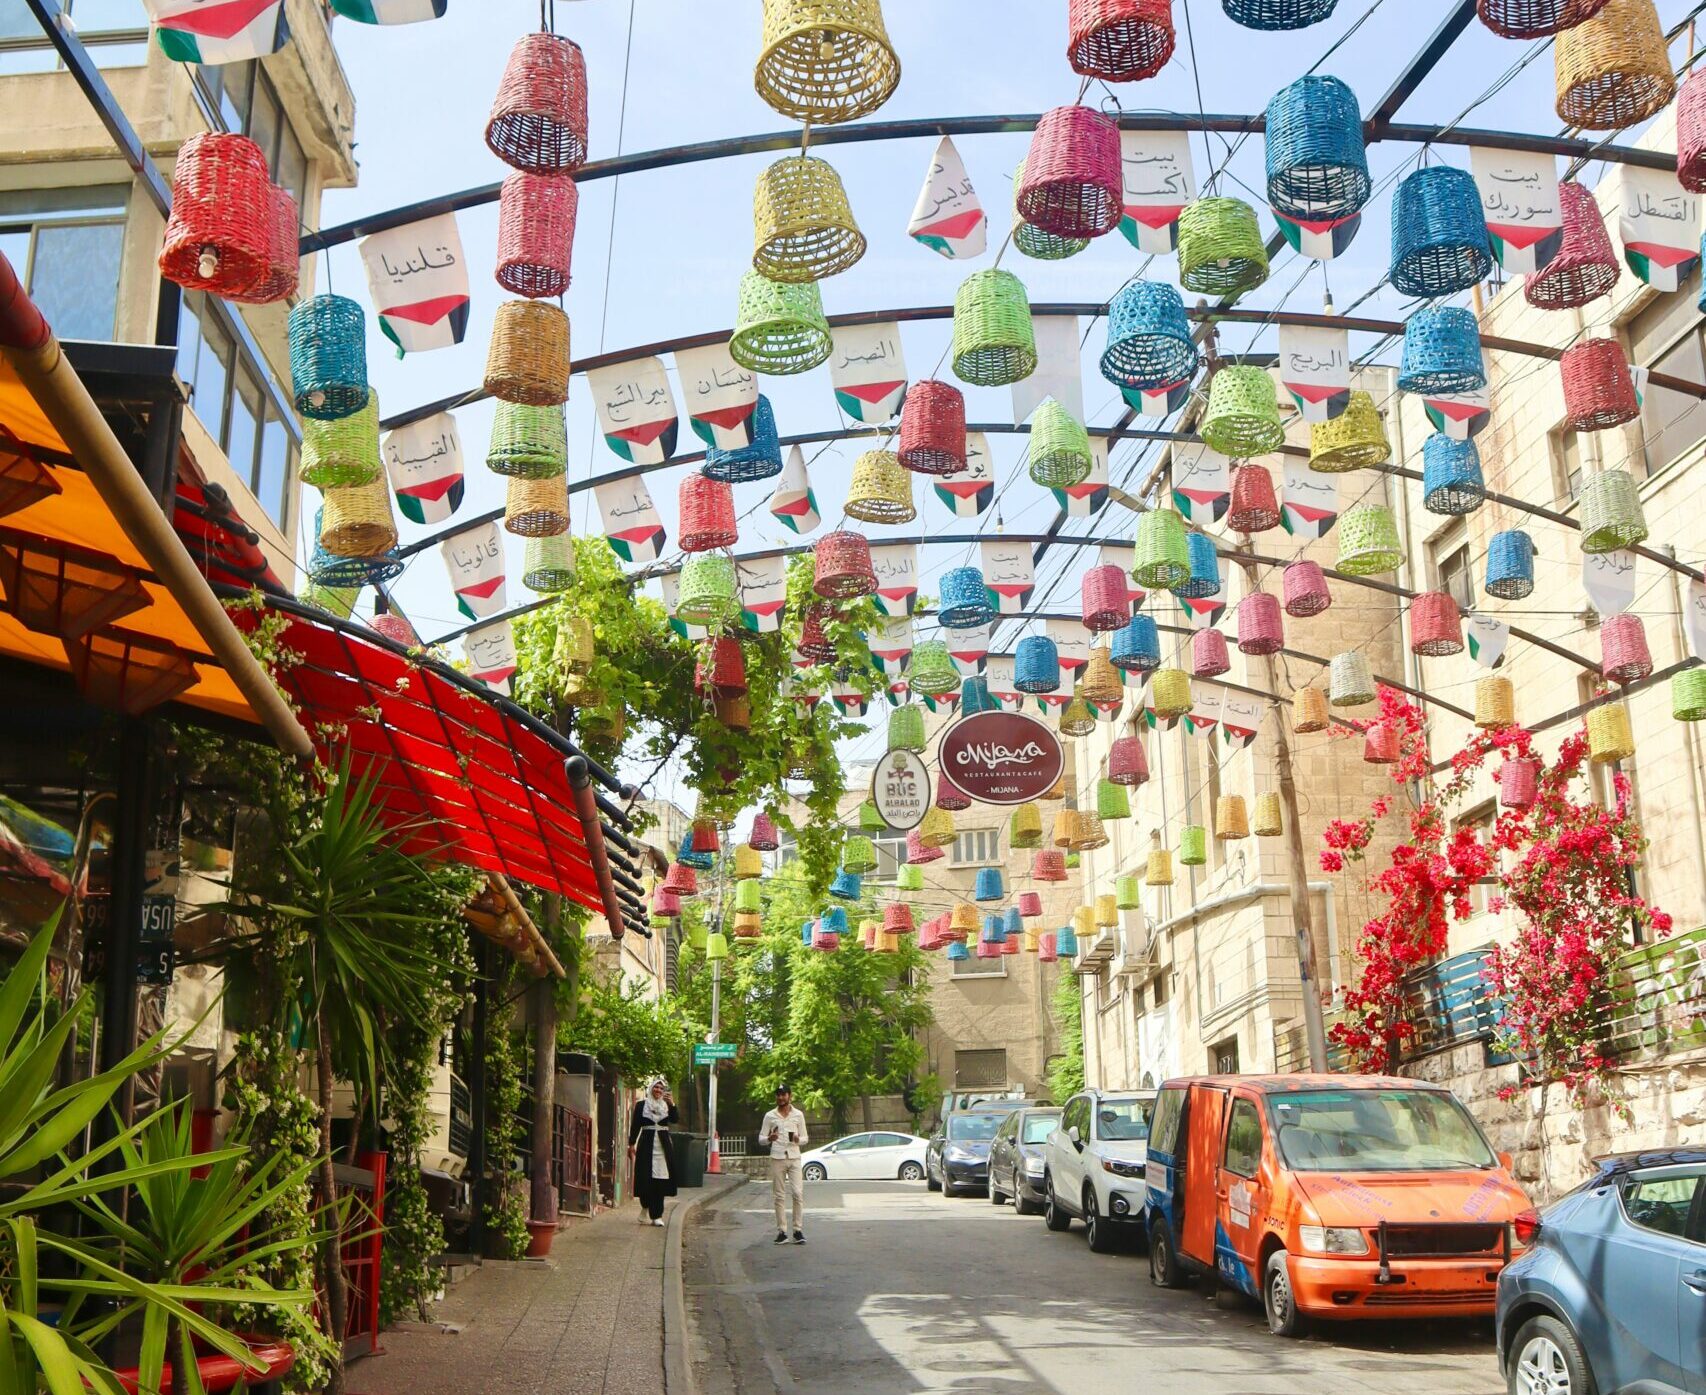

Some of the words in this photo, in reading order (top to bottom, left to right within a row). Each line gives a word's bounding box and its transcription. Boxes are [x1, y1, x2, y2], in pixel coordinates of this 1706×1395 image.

[1489, 169, 1541, 190] بيت
[1485, 192, 1553, 220] سوريك
[381, 246, 456, 284] قلنديا
[1289, 350, 1341, 373] البريج
[388, 434, 457, 472] القبيبة
[992, 551, 1020, 566] بيت
[886, 782, 917, 797] BUS
